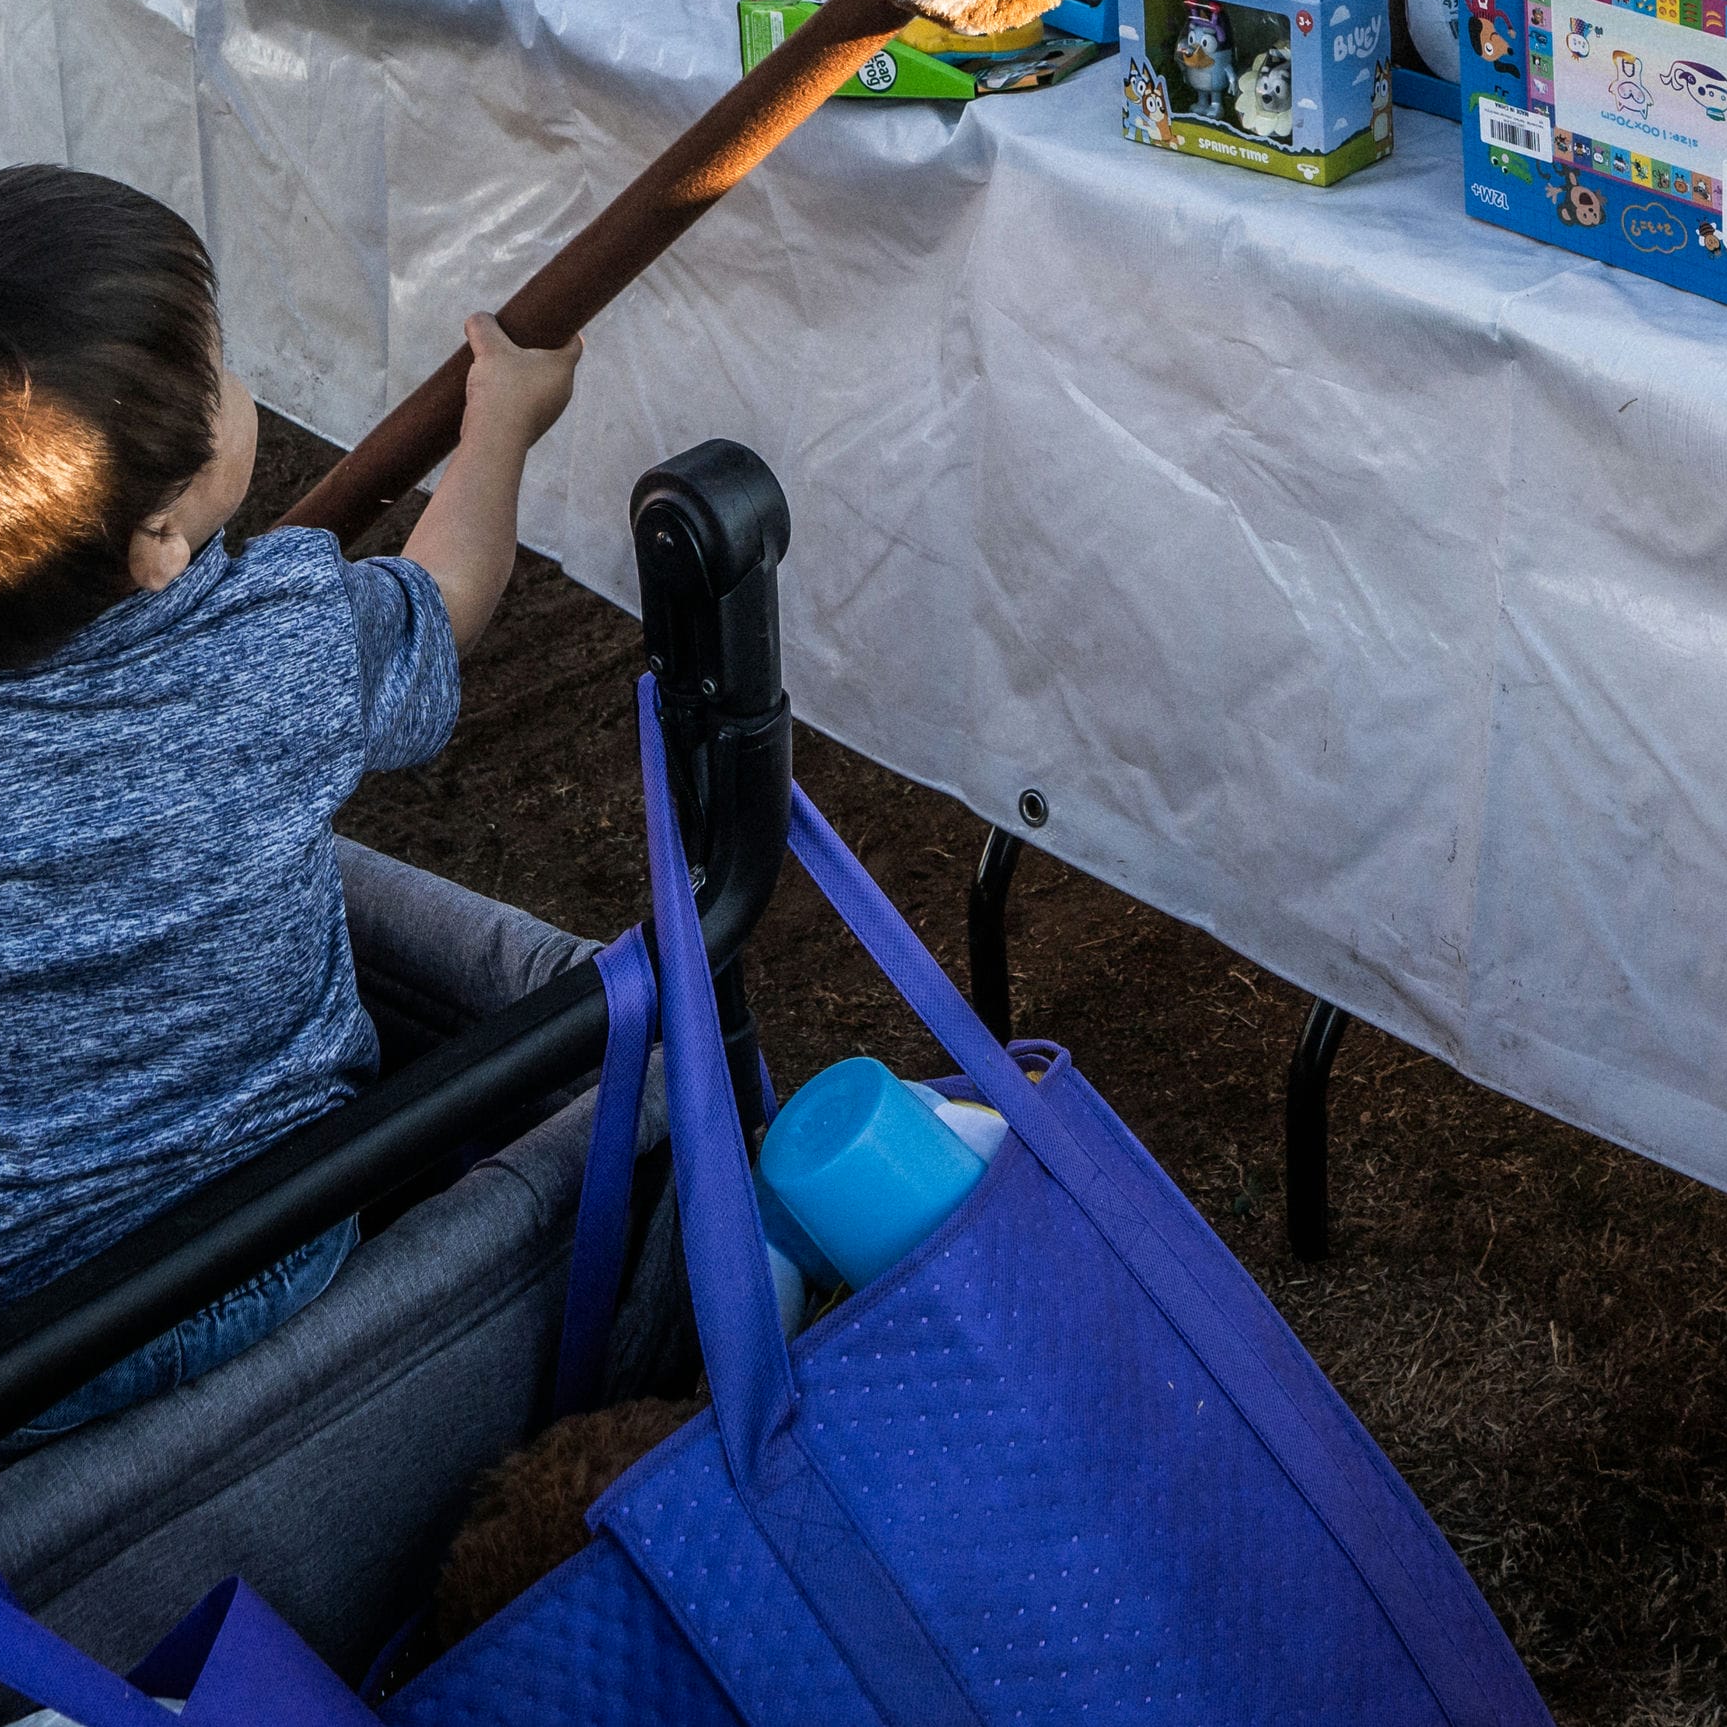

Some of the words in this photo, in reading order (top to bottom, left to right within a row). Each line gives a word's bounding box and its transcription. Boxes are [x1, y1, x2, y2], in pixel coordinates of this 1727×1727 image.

[1298, 16, 1311, 26] 3+
[1333, 15, 1381, 62] BLUEY
[866, 58, 881, 86] rog
[874, 54, 891, 83] Leap
[1471, 182, 1509, 211] 12M+
